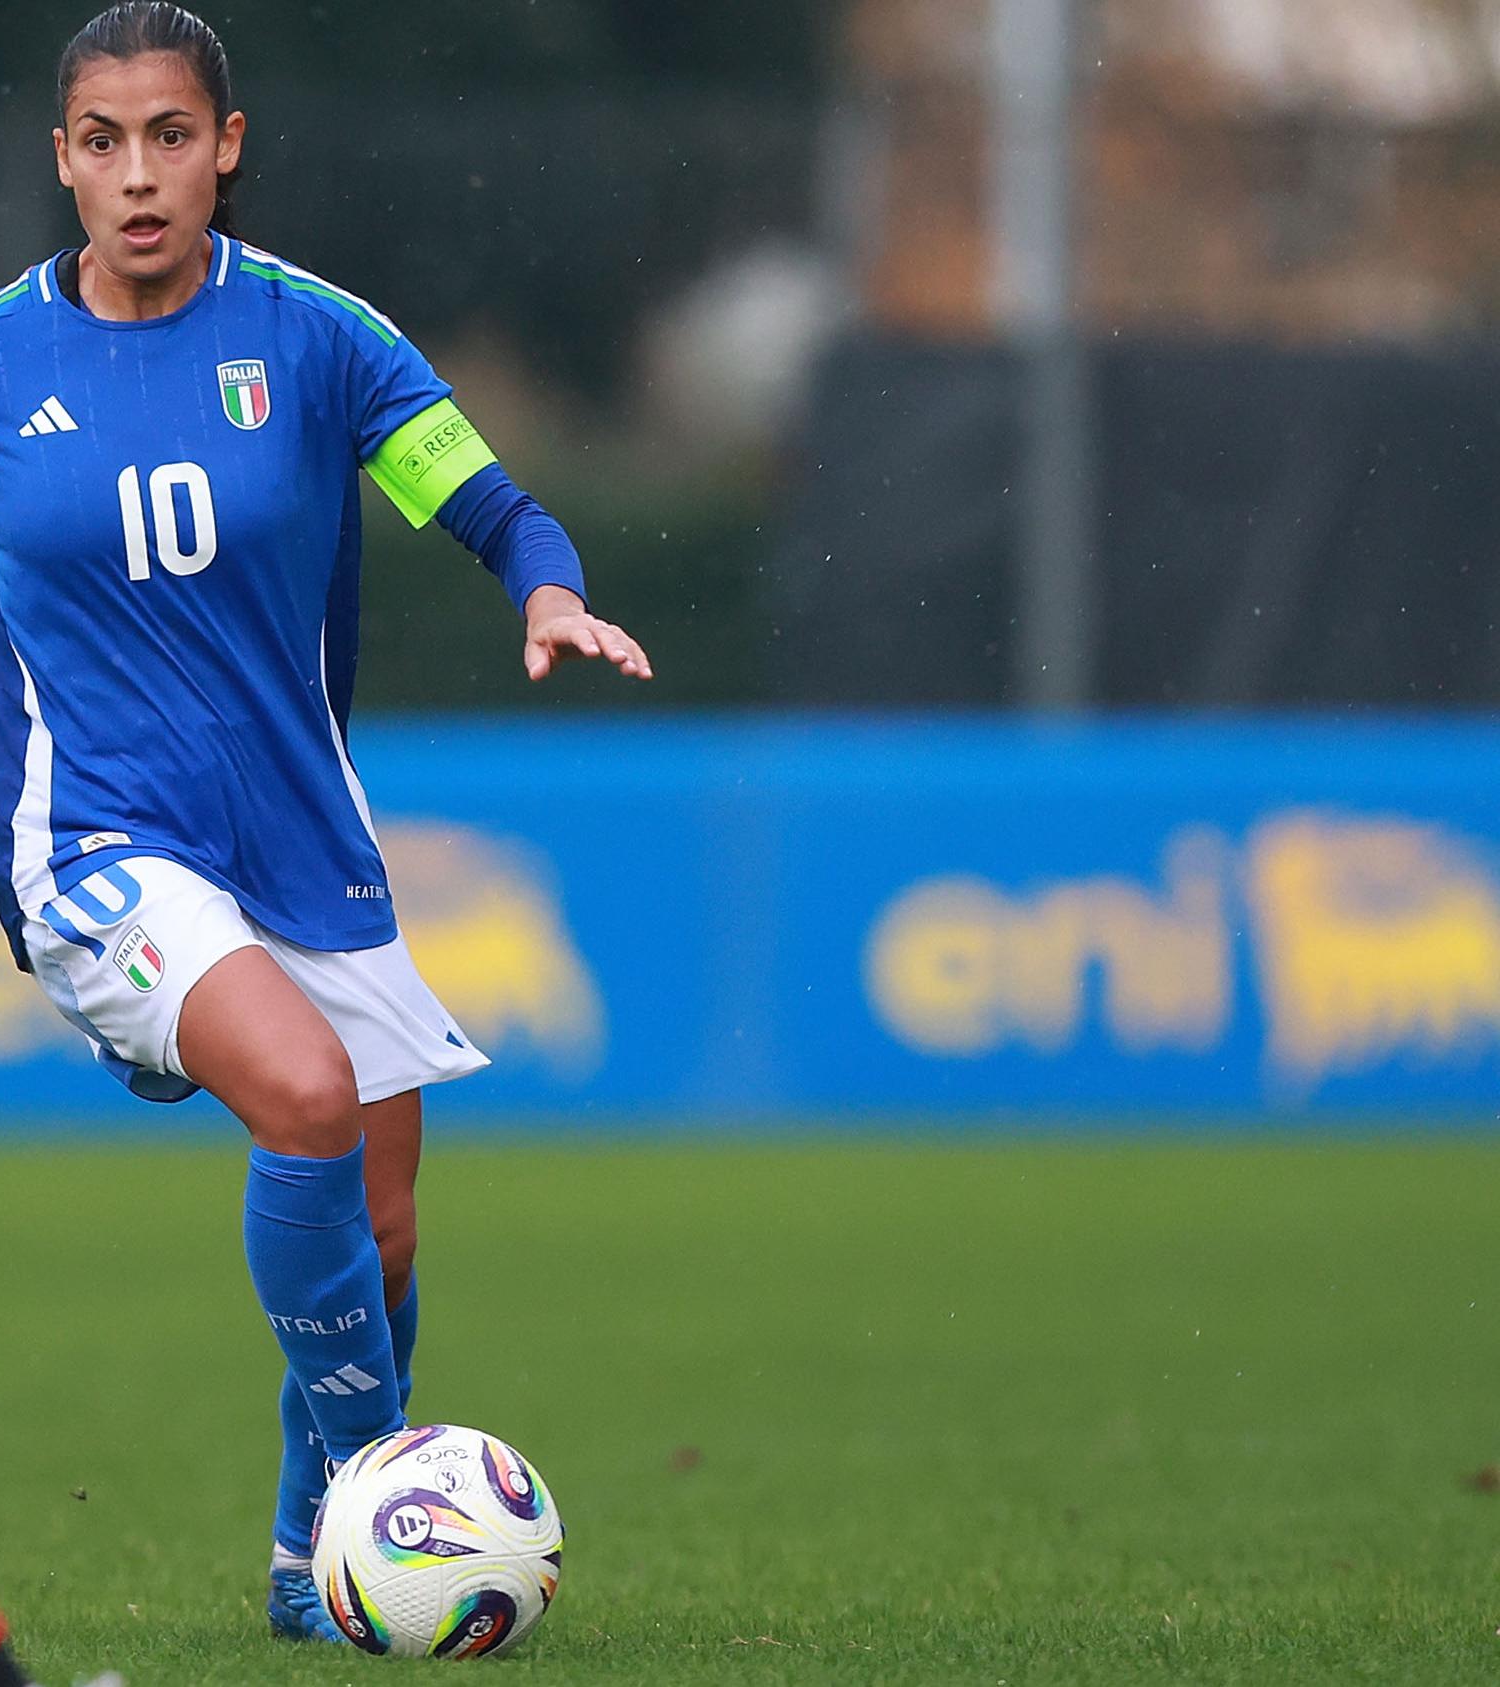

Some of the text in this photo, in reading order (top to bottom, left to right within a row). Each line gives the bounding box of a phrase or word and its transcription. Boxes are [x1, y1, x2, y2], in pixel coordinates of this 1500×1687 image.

[221, 365, 262, 382] ITALIA
[116, 460, 218, 582] 10
[116, 931, 143, 967] ITALIA
[266, 1307, 367, 1335] ITALIA
